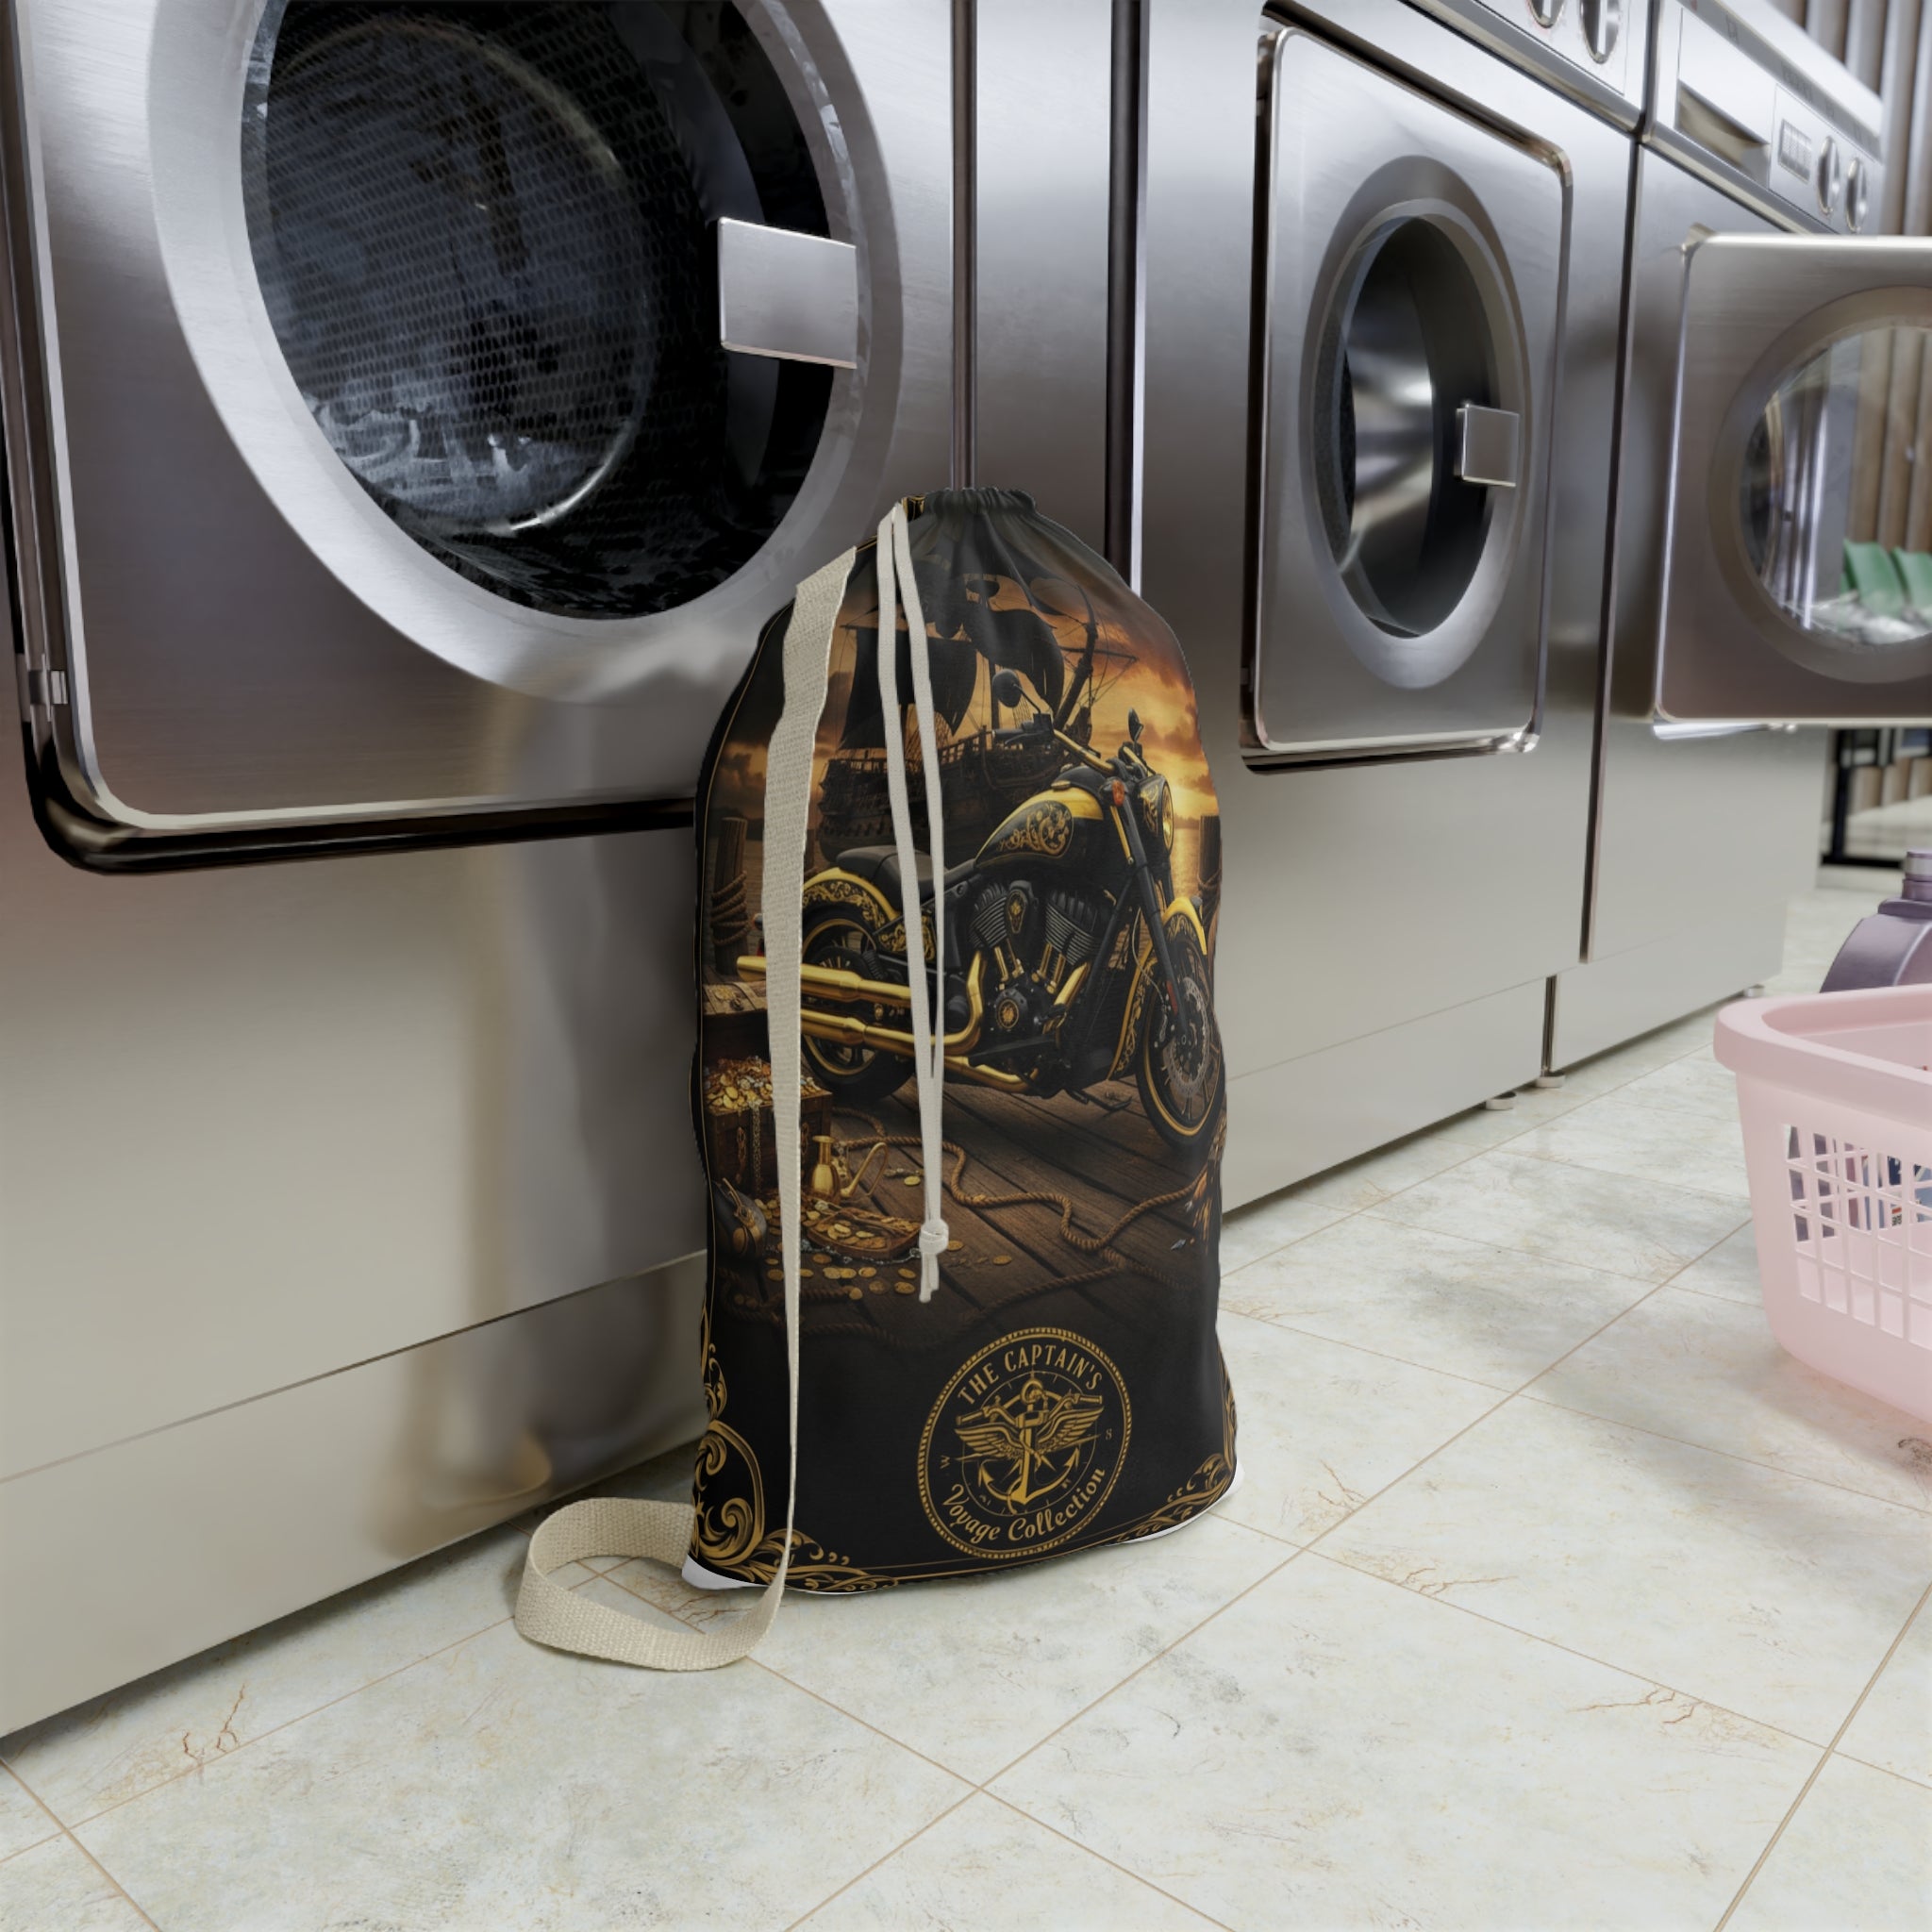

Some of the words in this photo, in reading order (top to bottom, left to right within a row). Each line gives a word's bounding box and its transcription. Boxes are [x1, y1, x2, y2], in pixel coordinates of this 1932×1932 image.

[958, 1362, 999, 1405] THE
[1004, 1344, 1103, 1391] CAPTAIN'S
[943, 1483, 1001, 1544] Voyage
[1008, 1468, 1106, 1541] Collection
